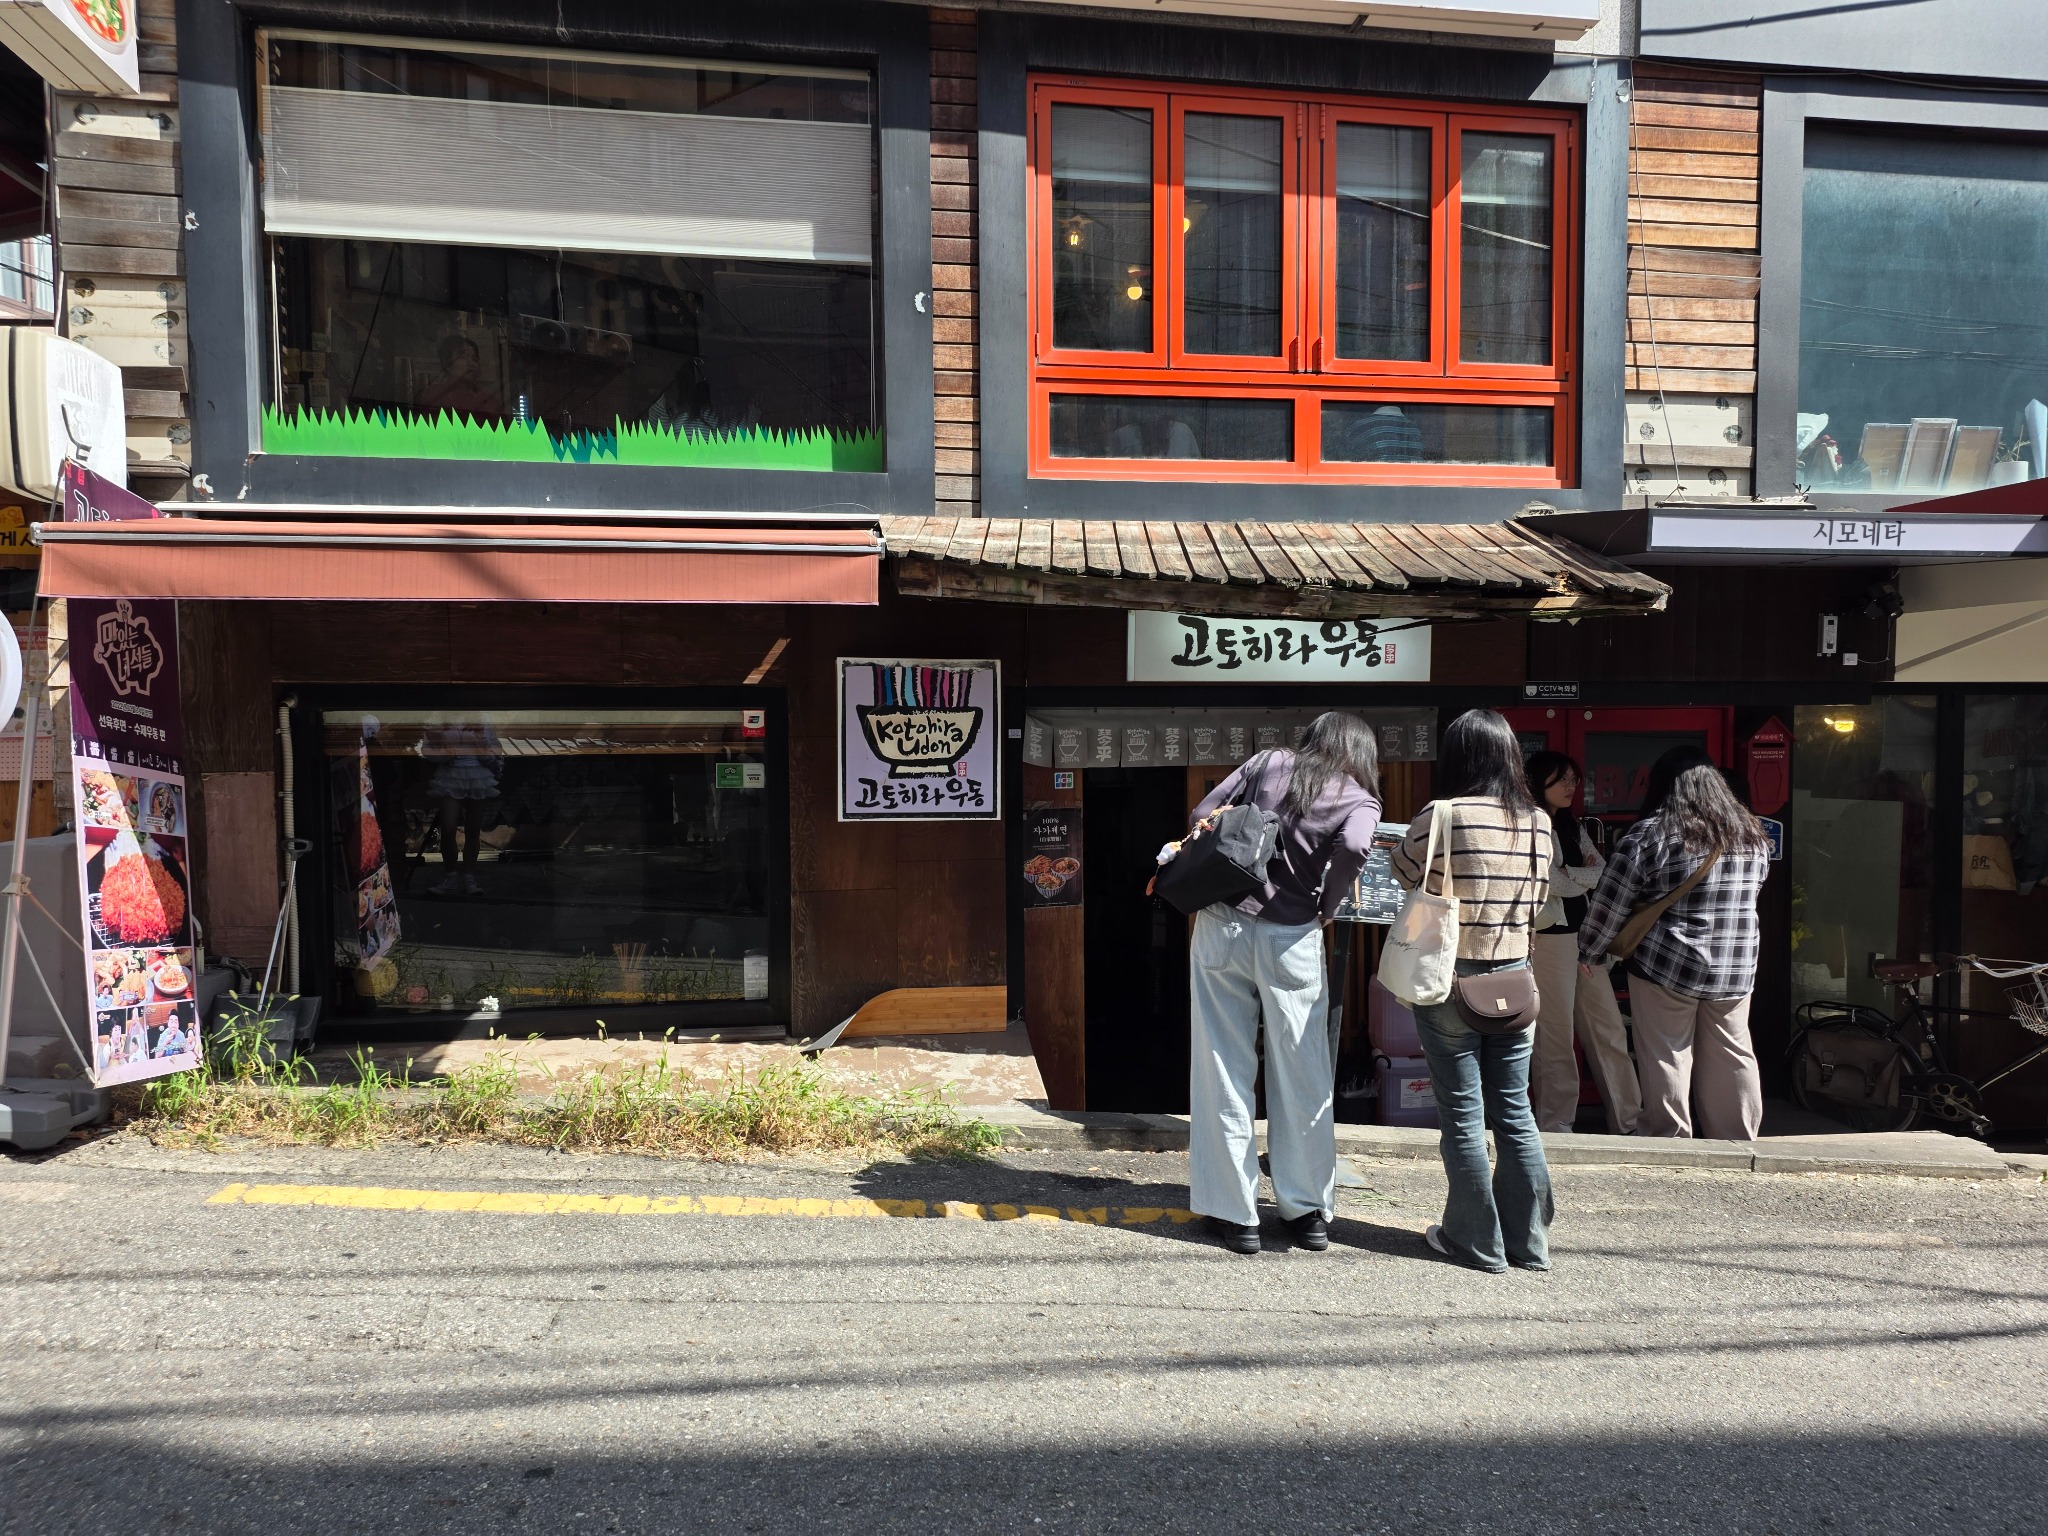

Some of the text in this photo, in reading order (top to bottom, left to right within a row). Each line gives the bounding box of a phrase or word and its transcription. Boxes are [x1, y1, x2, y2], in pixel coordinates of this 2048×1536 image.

[1813, 520, 1907, 547] 시모네타
[102, 619, 139, 658] 맛있는
[1171, 615, 1383, 669] 고토히라 우동
[116, 643, 153, 682] 녀석들
[98, 714, 127, 733] 선육후면
[134, 722, 159, 740] 수제우동
[159, 729, 167, 742] 편
[876, 716, 964, 743] Kotohira
[897, 737, 952, 757] Udon
[854, 778, 985, 810] 고토히라 우동
